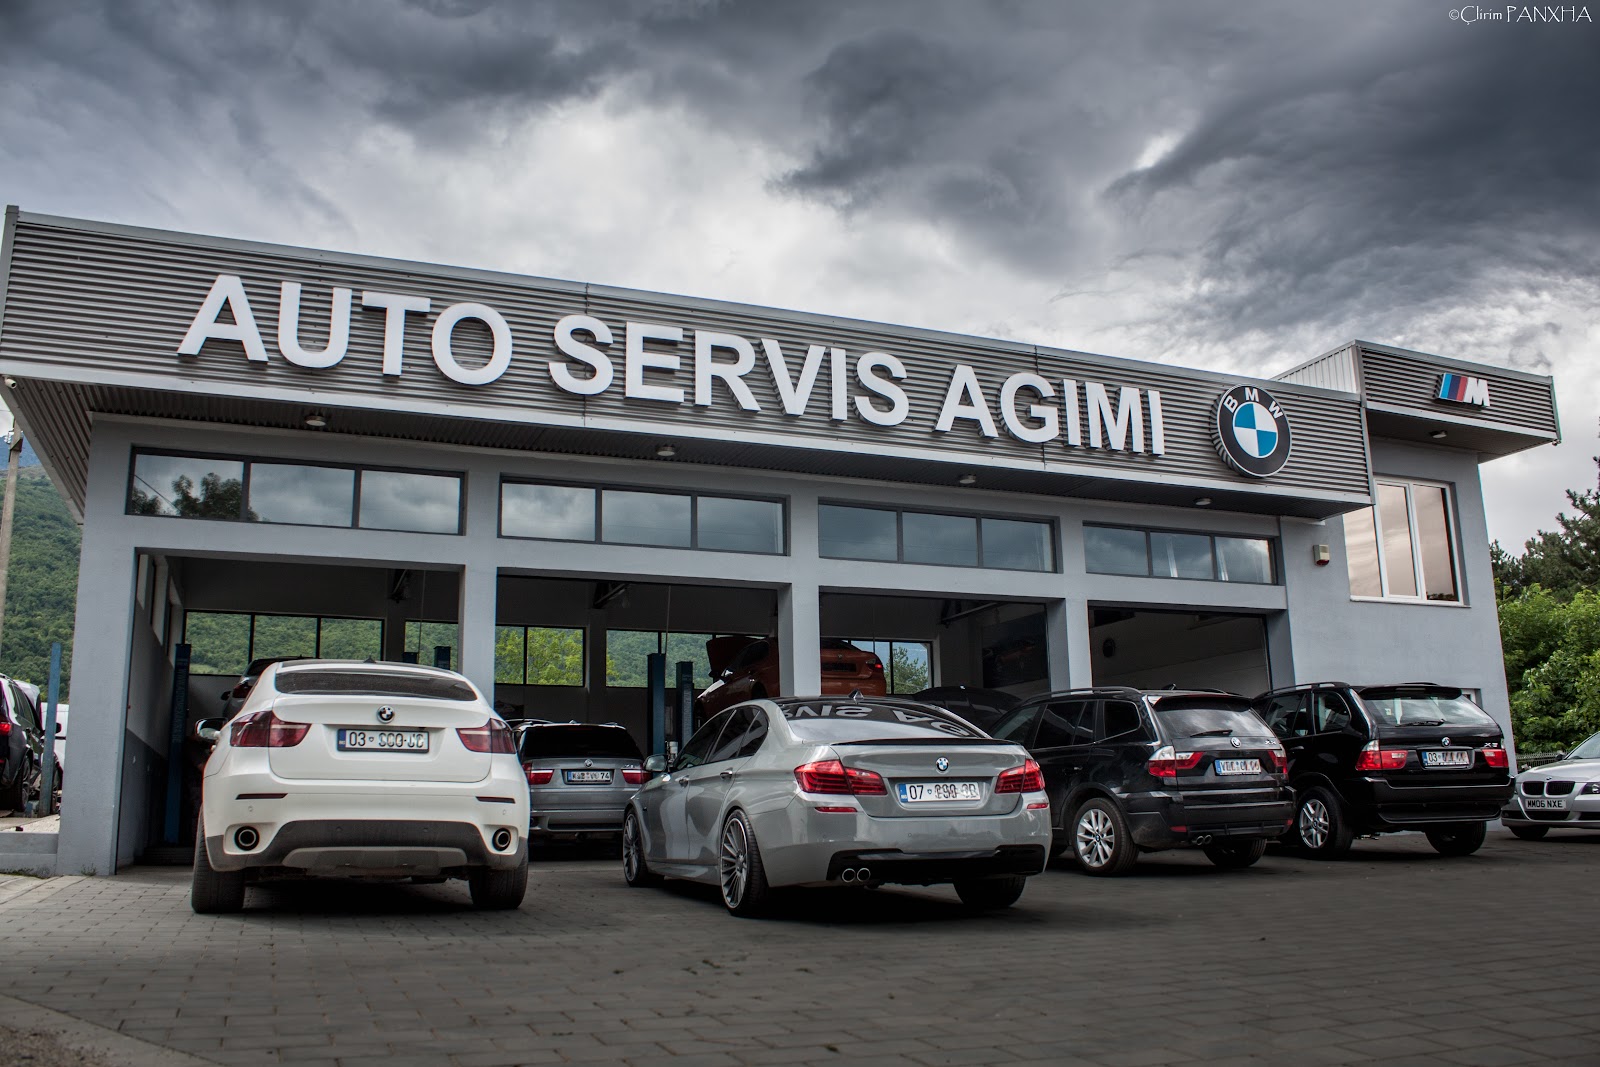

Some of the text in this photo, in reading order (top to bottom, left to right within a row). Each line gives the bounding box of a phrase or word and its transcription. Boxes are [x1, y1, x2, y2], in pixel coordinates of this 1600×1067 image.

[178, 274, 1166, 457] AUTO SERVIS AGIMI
[1223, 387, 1284, 419] BMW
[349, 731, 366, 747] 03
[600, 772, 610, 780] 74
[909, 784, 924, 800] 07
[1527, 800, 1563, 808] MM06 NXE
